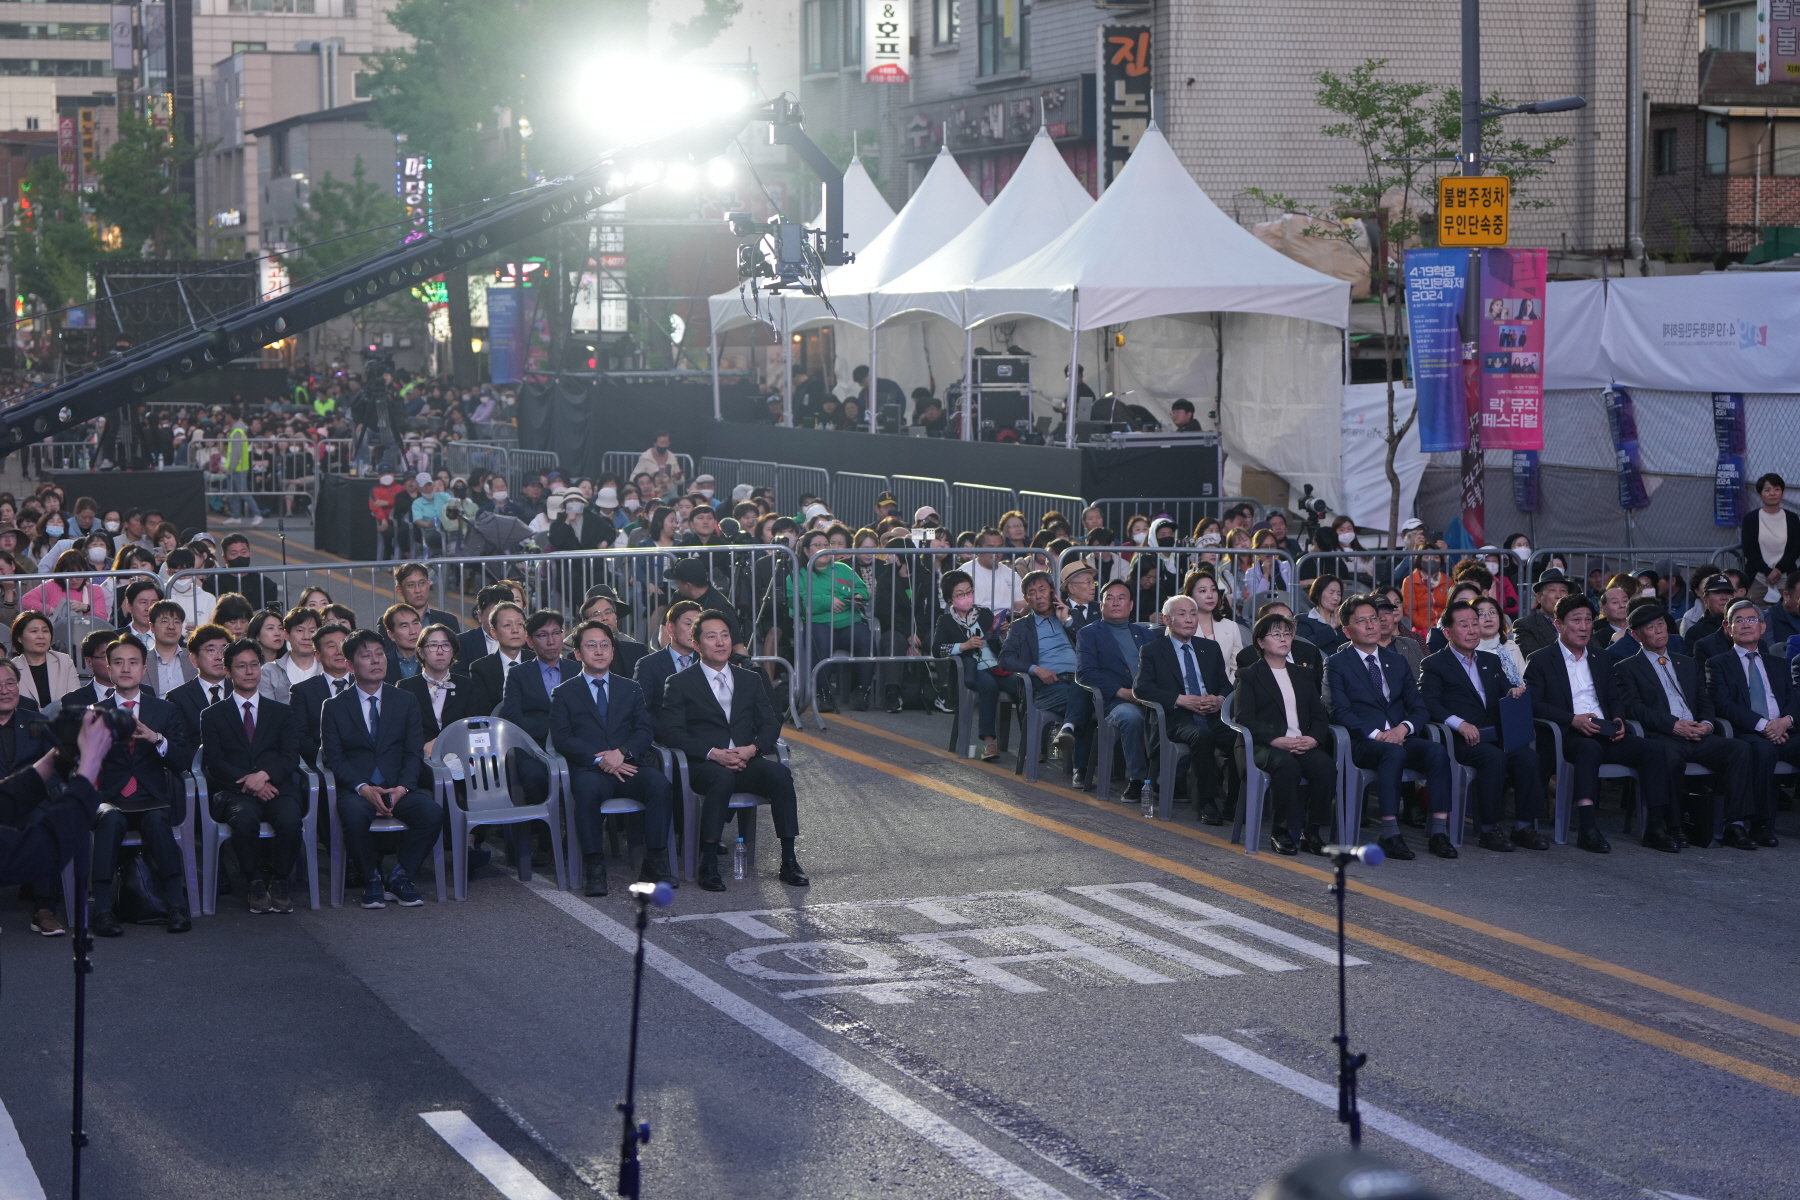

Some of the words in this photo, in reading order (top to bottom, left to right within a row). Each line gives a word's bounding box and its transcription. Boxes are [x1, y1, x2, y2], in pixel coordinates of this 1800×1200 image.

[1444, 186, 1504, 208] 불법주정차
[1443, 214, 1504, 236] 무인단속중
[1410, 278, 1464, 290] 국민문화제
[1412, 291, 1443, 301] 2024
[1490, 398, 1505, 412] 락
[1511, 398, 1539, 412] 뮤직
[1482, 413, 1538, 428] 페스티벌
